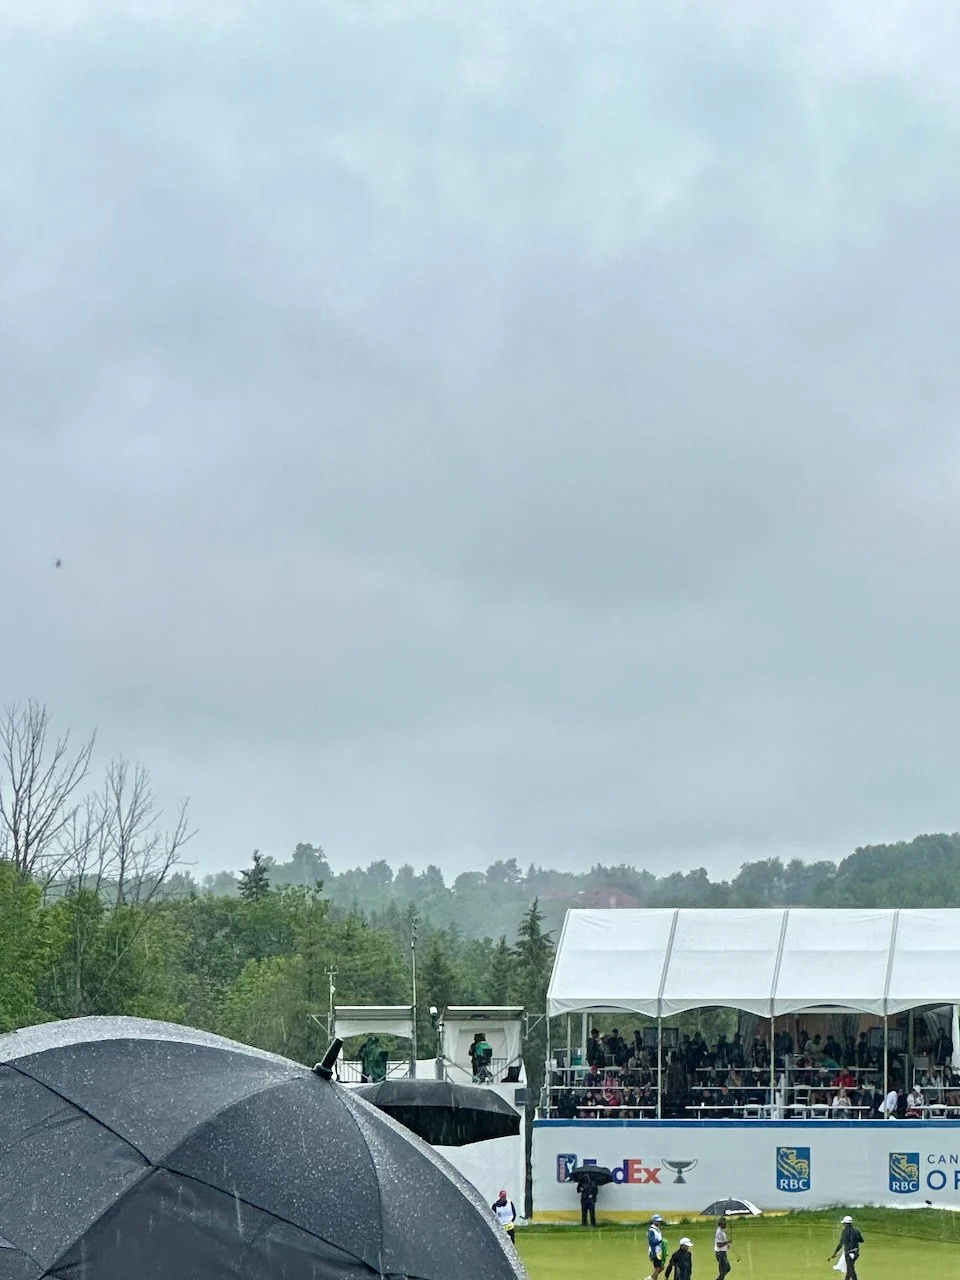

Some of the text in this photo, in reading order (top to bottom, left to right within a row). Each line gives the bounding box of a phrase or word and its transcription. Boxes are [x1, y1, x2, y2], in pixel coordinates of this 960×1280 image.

[583, 1159, 661, 1184] dEx
[780, 1179, 807, 1189] RBC
[892, 1181, 917, 1191] RBC
